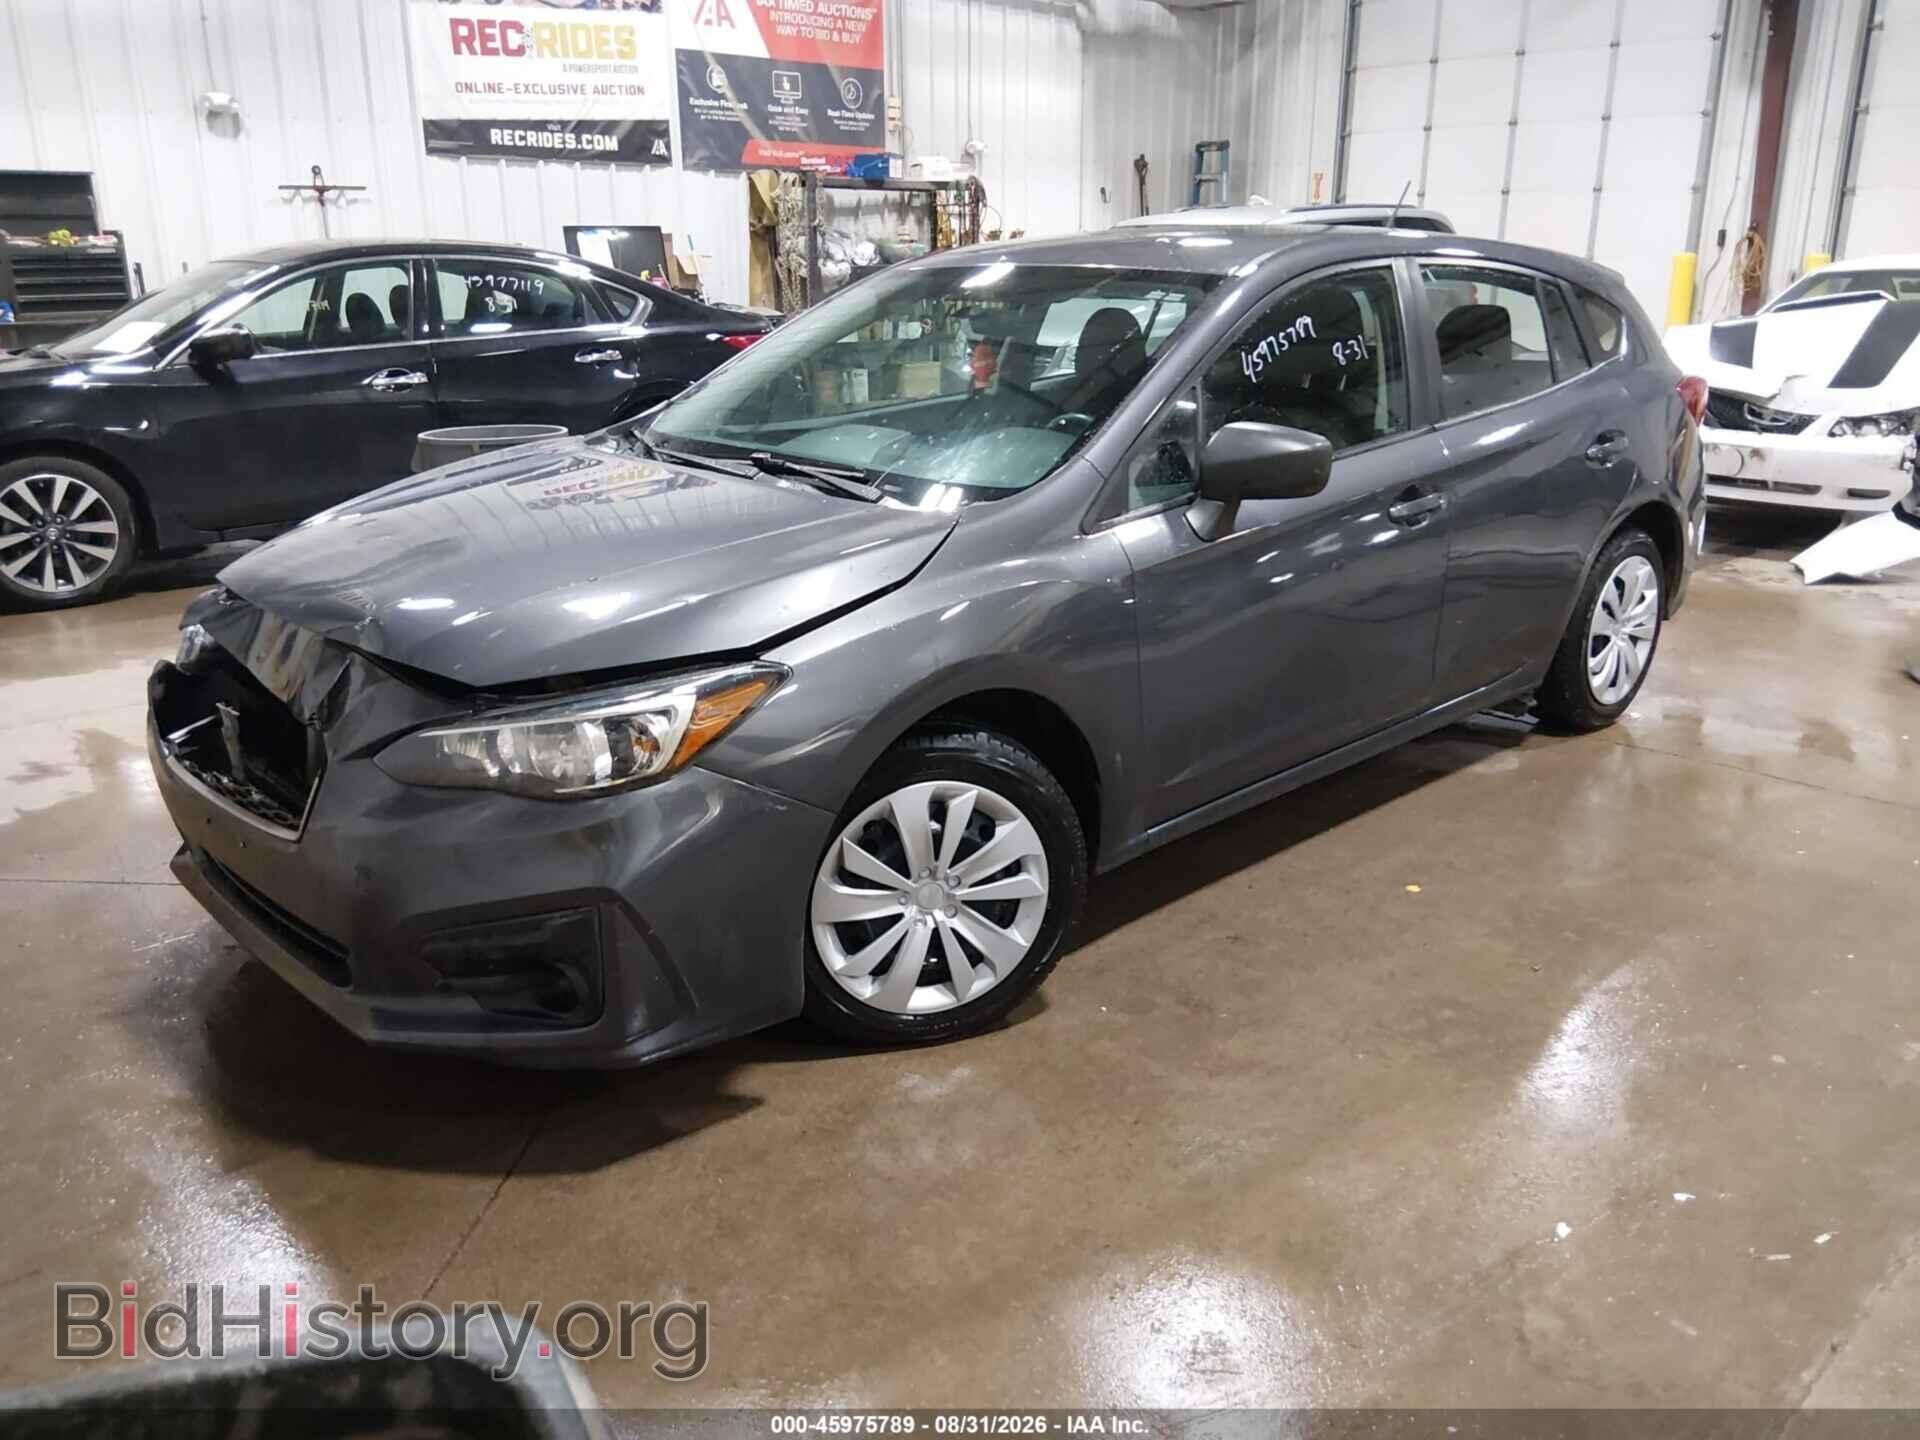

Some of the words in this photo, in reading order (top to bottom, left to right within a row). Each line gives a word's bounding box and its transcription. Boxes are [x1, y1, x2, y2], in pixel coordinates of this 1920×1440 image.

[455, 82, 587, 95] ONLINE-EXCLUSIVE
[593, 84, 645, 96] AUCTION
[490, 128, 619, 151] RECRIDES.COM
[1332, 335, 1369, 366] 8-31
